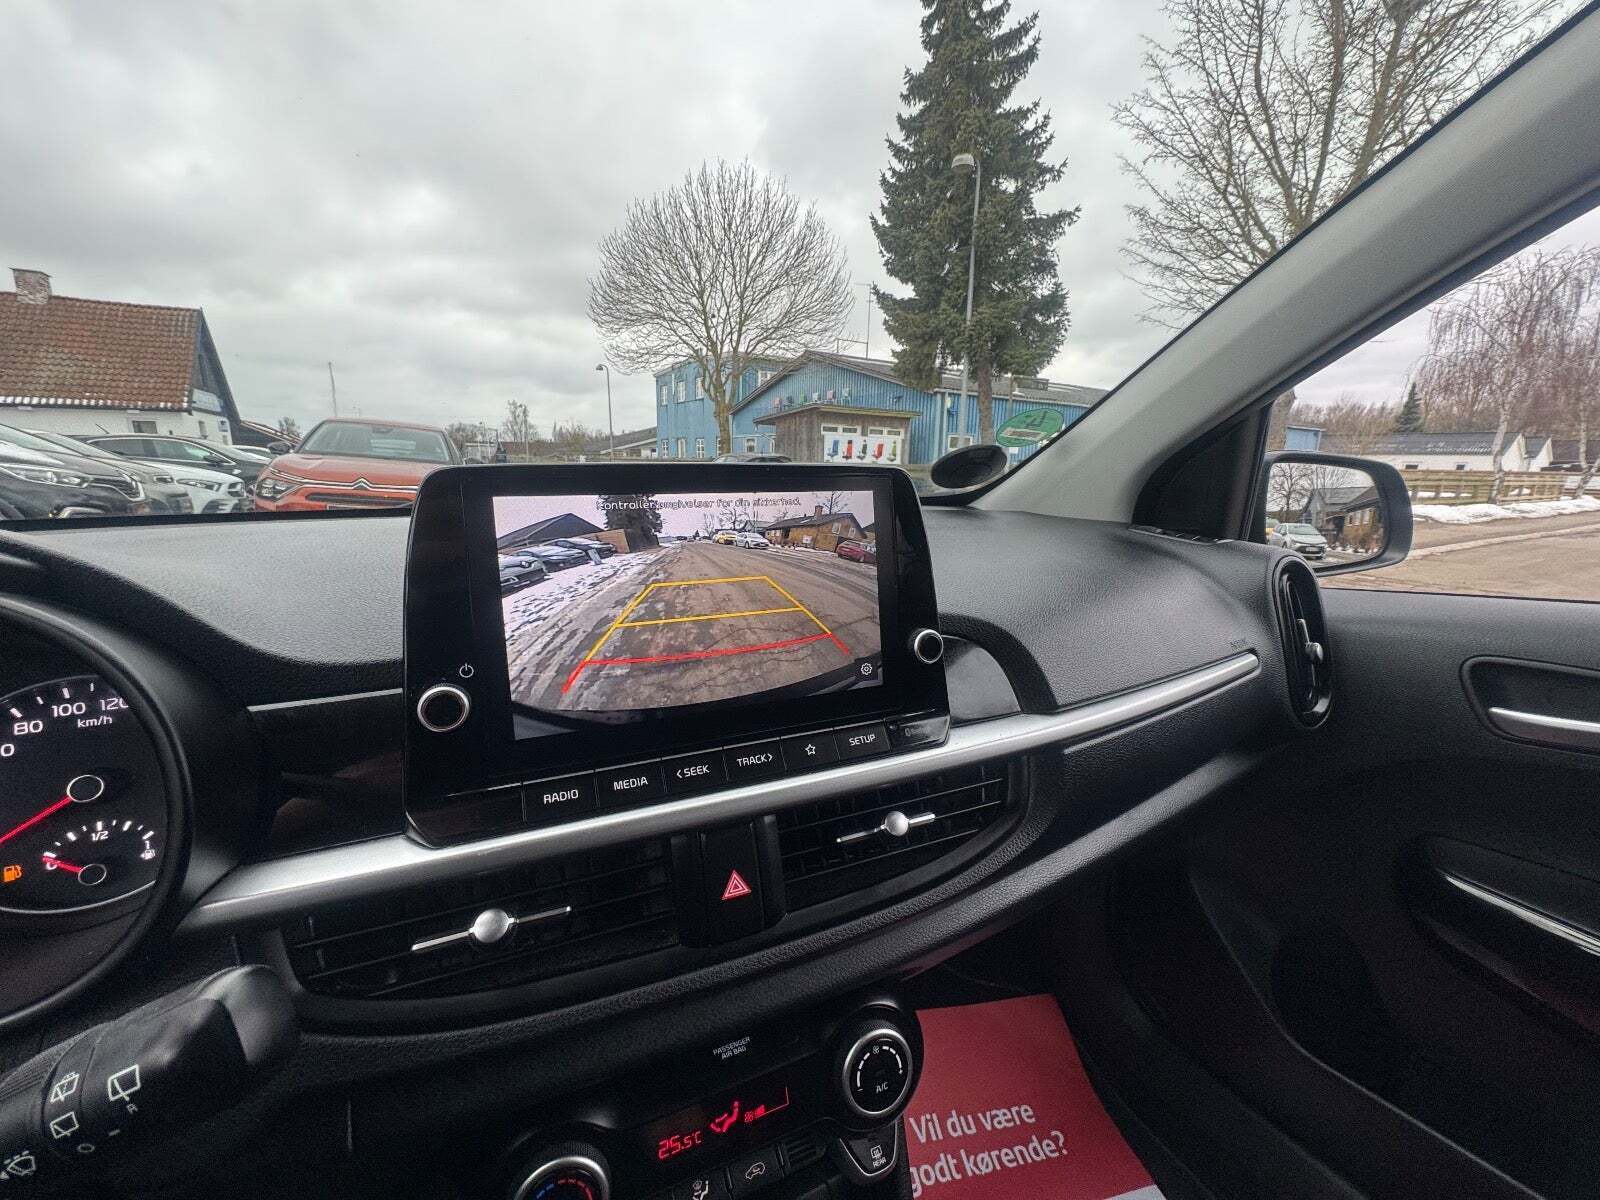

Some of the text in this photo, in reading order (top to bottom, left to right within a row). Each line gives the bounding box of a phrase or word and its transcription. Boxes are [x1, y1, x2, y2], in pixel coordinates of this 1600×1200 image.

[51, 702, 86, 718] 100
[13, 720, 44, 736] 80
[77, 715, 113, 728] km/h
[848, 733, 876, 746] SETUP
[613, 776, 648, 791] MEDIA
[543, 789, 579, 805] RADIO
[91, 830, 109, 841] 1/2
[712, 1036, 750, 1056] PASSENGER
[721, 1045, 747, 1061] AIR BAG
[876, 1081, 889, 1094] A/C
[909, 1104, 1036, 1144] Vil du være
[872, 1156, 887, 1169] REAR
[909, 1130, 1068, 1198] godt kørende?
